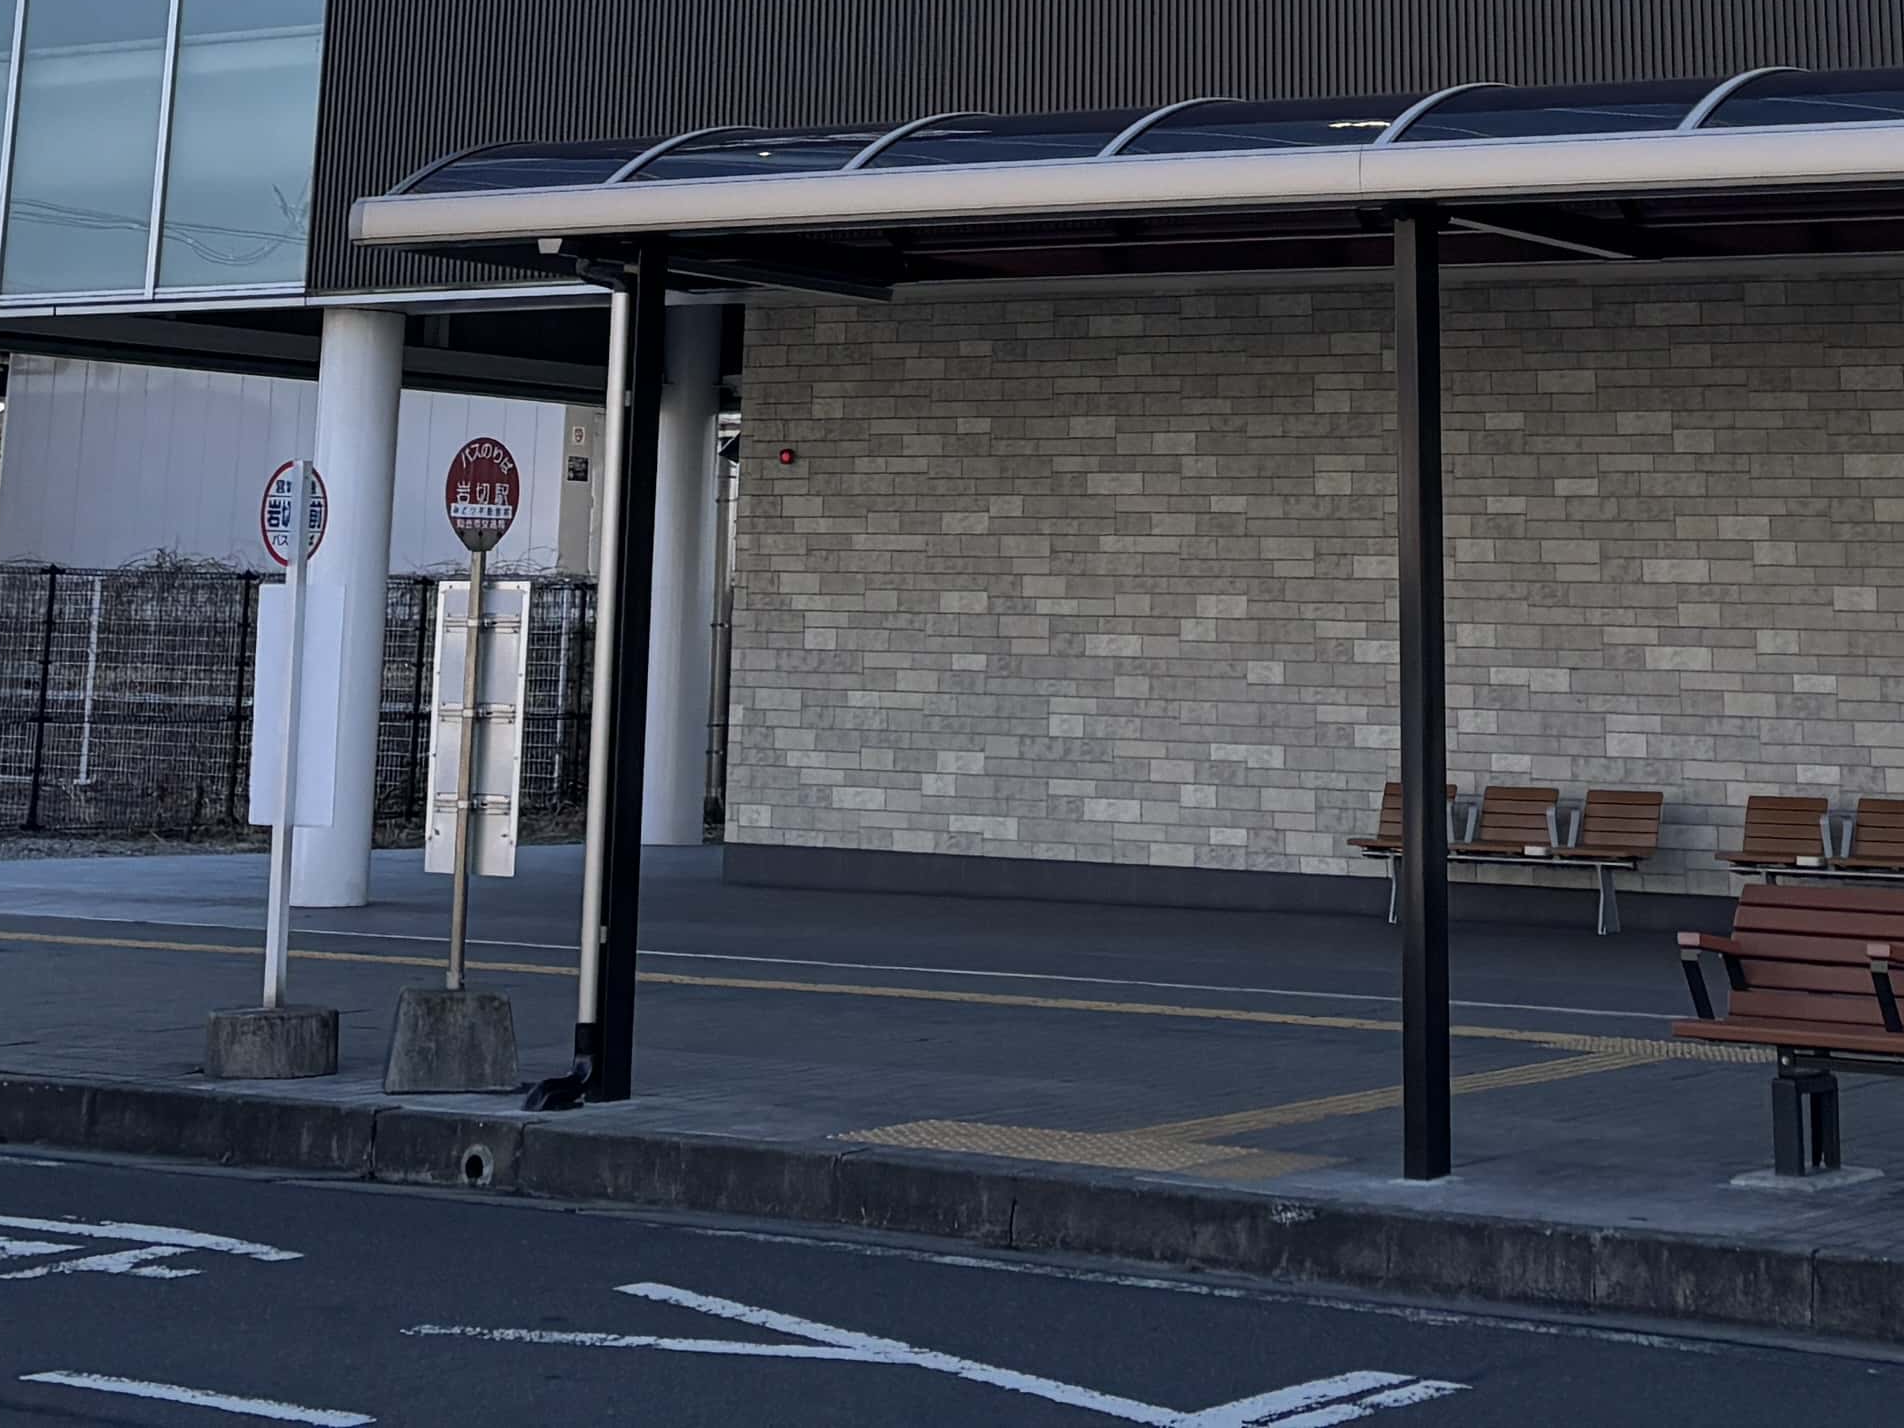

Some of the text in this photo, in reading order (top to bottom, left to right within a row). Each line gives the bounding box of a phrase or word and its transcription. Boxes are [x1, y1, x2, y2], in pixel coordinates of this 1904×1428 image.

[461, 443, 514, 475] バスのりば
[456, 481, 510, 505] 岩切駅
[267, 499, 323, 529] 岩切前
